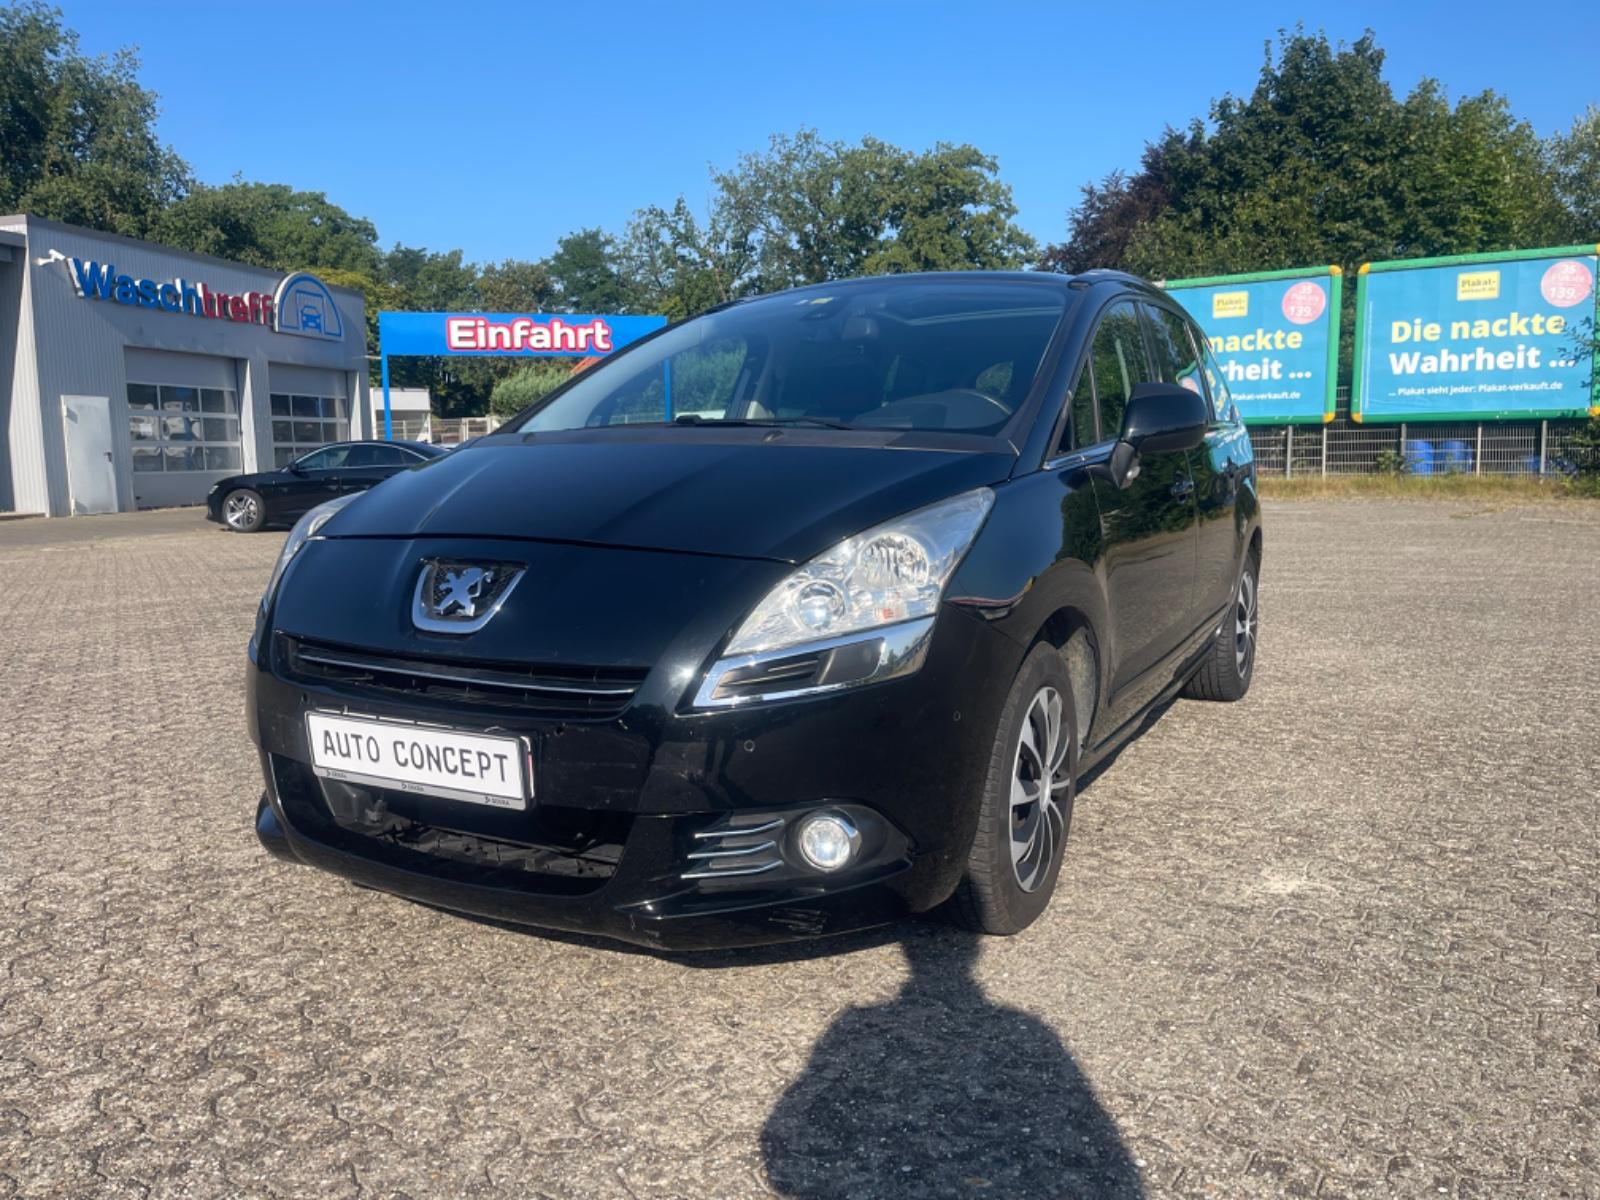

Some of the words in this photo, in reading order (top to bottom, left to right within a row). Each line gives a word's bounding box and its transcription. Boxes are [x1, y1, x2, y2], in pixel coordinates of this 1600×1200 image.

[68, 257, 274, 326] Waschtreff
[449, 319, 611, 350] Einfahrt
[1208, 328, 1303, 353] nackte
[1391, 318, 1442, 343] Die
[1450, 312, 1566, 340] nackte
[1389, 344, 1541, 375] Wahrheit
[323, 729, 381, 763] AUTO
[392, 740, 509, 783] CONCEPT
